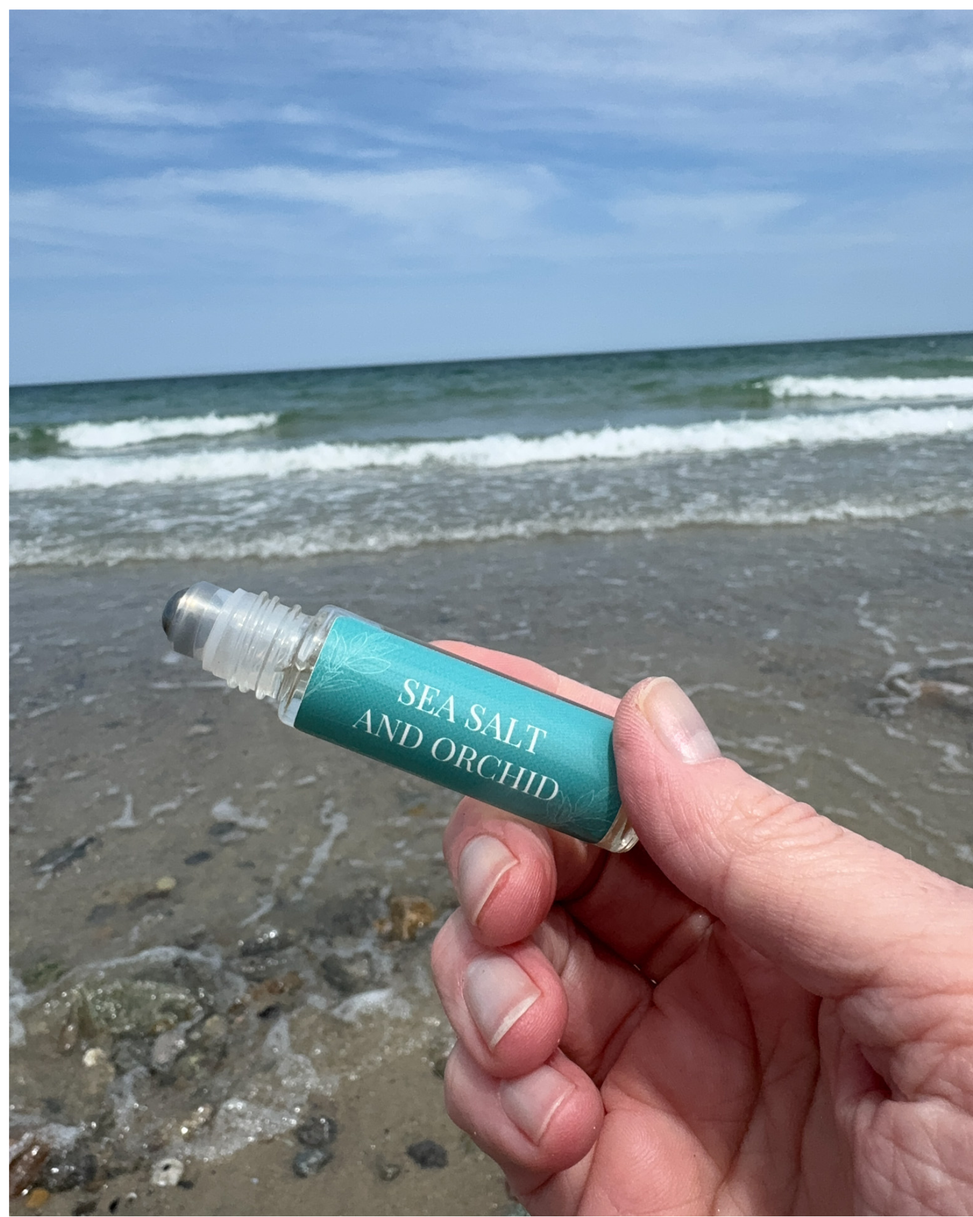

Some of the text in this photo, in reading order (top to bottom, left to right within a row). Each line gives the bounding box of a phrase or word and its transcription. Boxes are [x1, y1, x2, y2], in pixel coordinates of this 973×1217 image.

[352, 708, 560, 802] AND ORCHID
[397, 678, 548, 756] SEA SALT
